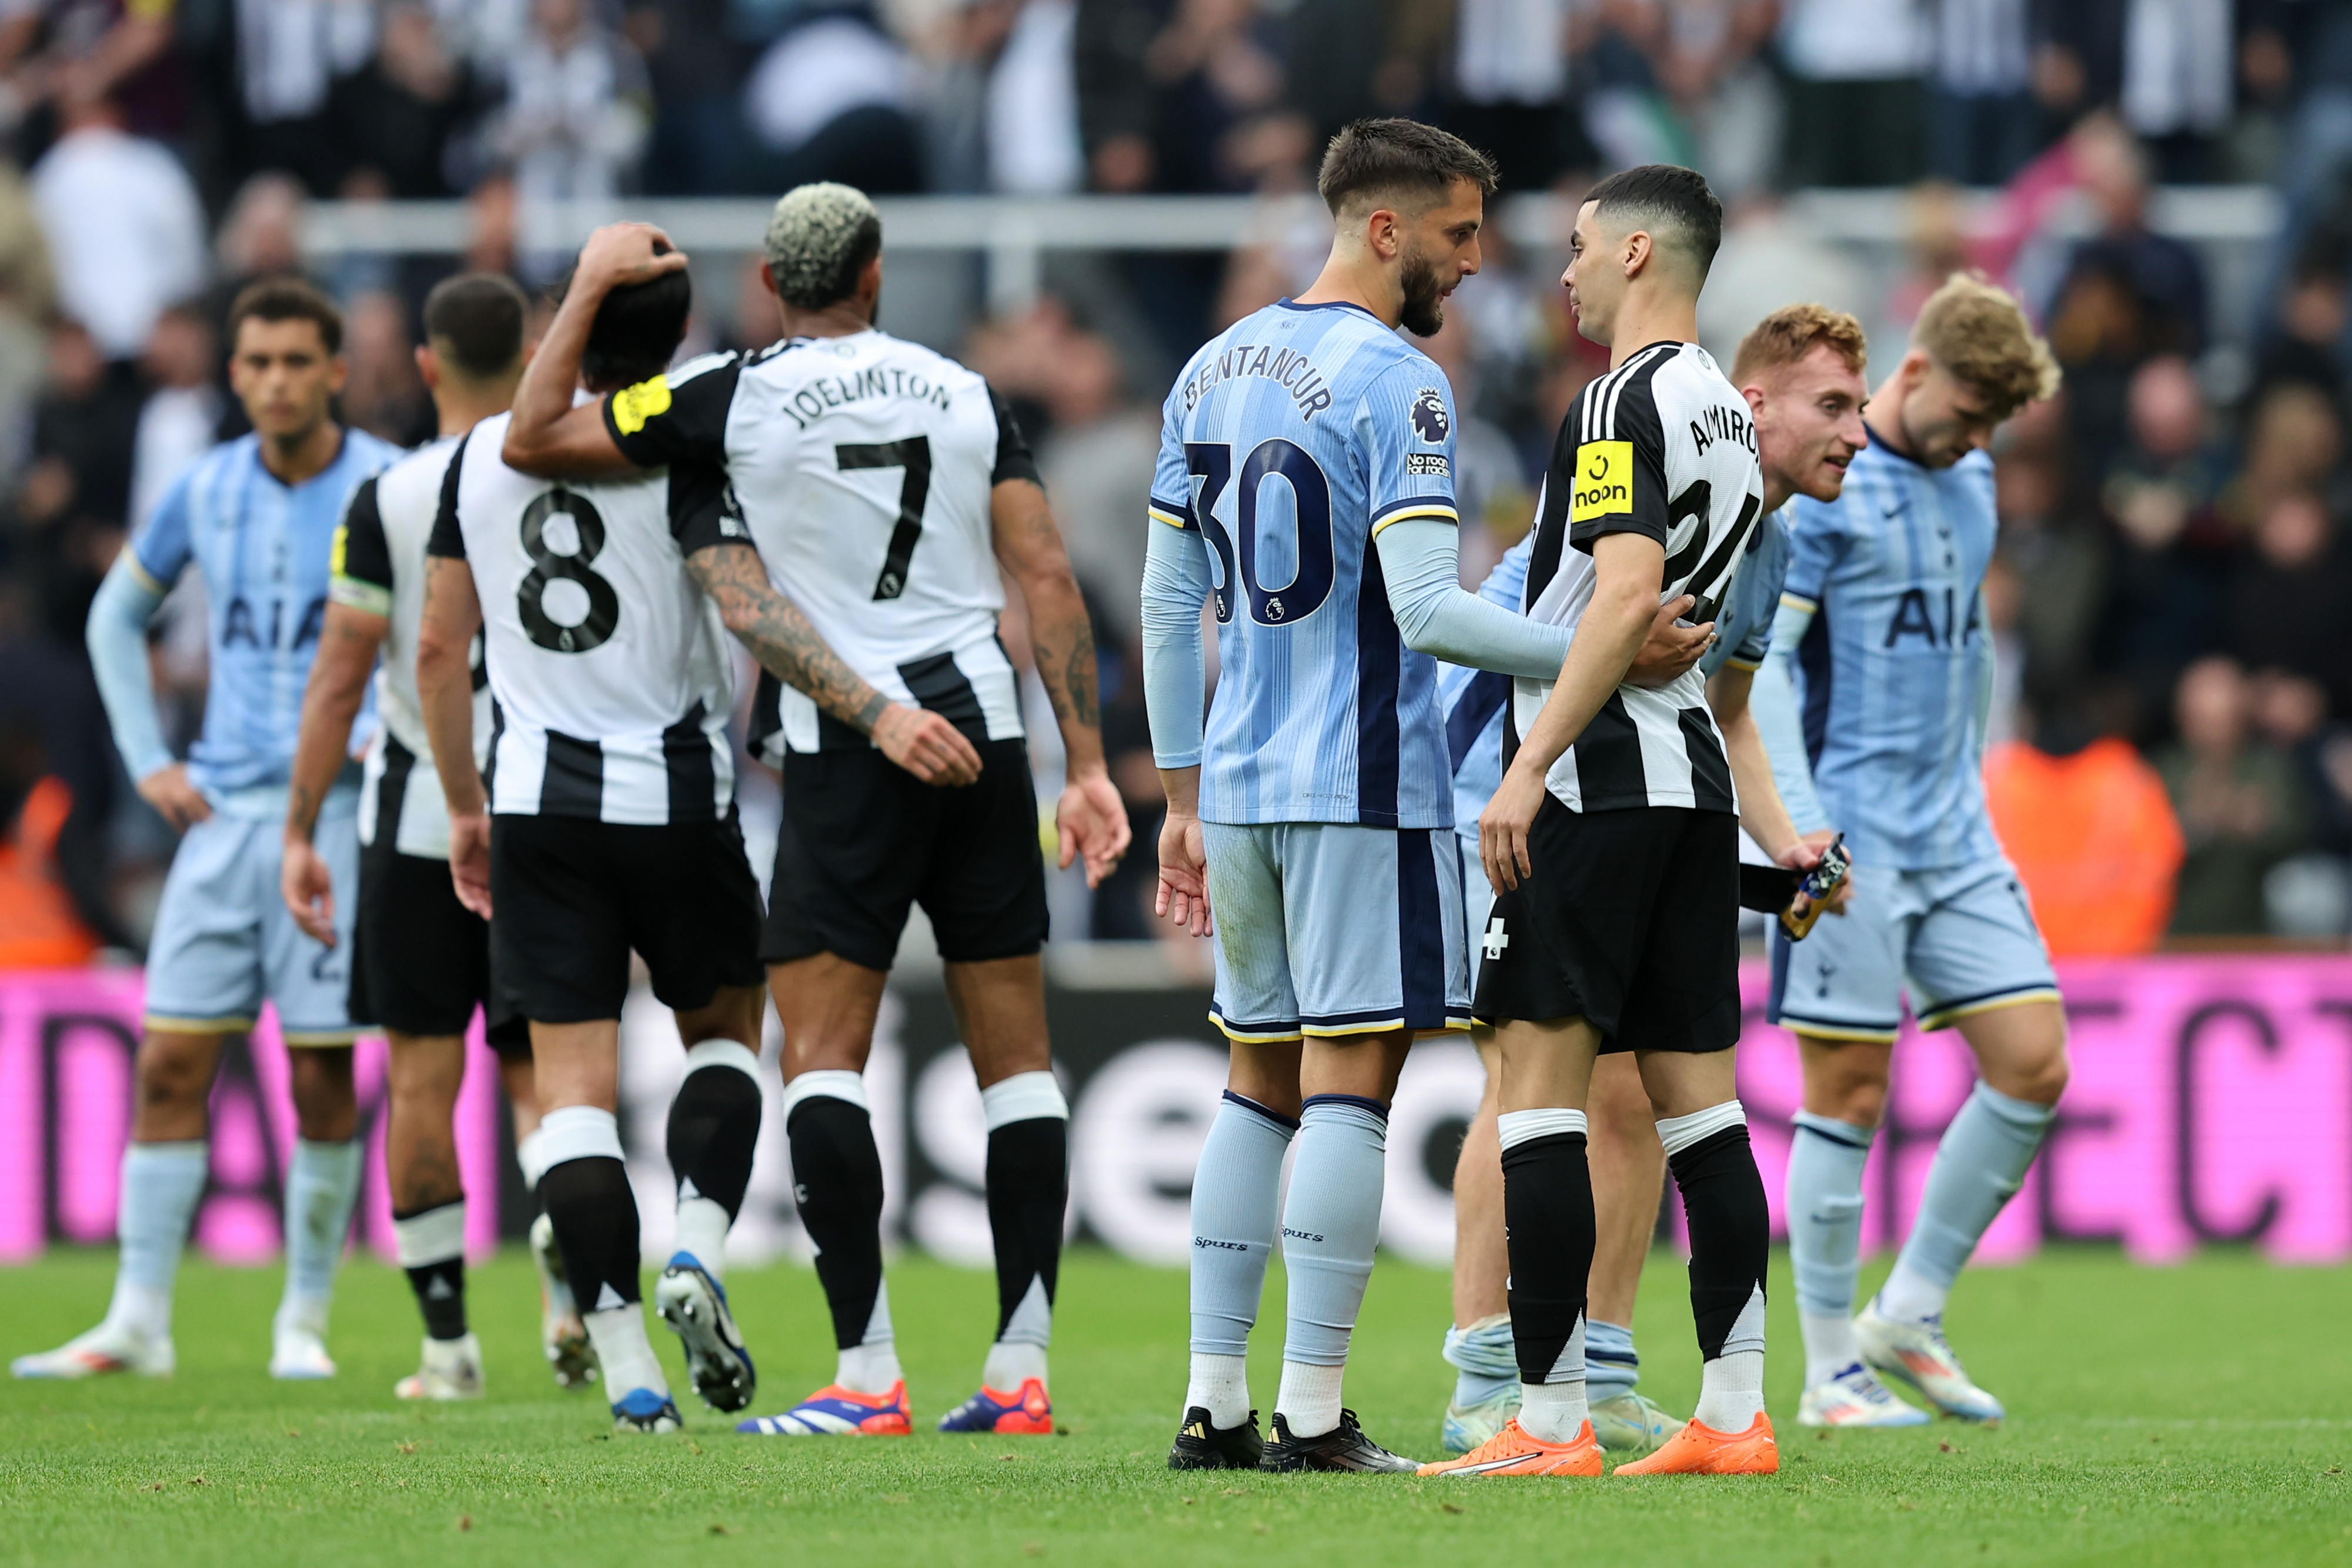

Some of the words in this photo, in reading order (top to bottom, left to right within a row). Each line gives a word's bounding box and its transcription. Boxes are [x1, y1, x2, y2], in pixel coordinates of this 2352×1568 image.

[783, 367, 950, 430] JOELINTON
[1184, 344, 1333, 423] BENTANCUR
[1406, 454, 1424, 465] No
[1406, 464, 1424, 474] for
[1690, 404, 1762, 476] ALMIRO
[835, 436, 932, 602] 7
[1575, 484, 1626, 508] noon
[1183, 437, 1336, 627] 30
[517, 487, 619, 653] 8
[1195, 1236, 1248, 1252] Spurs
[1282, 1224, 1324, 1242] Spurs
